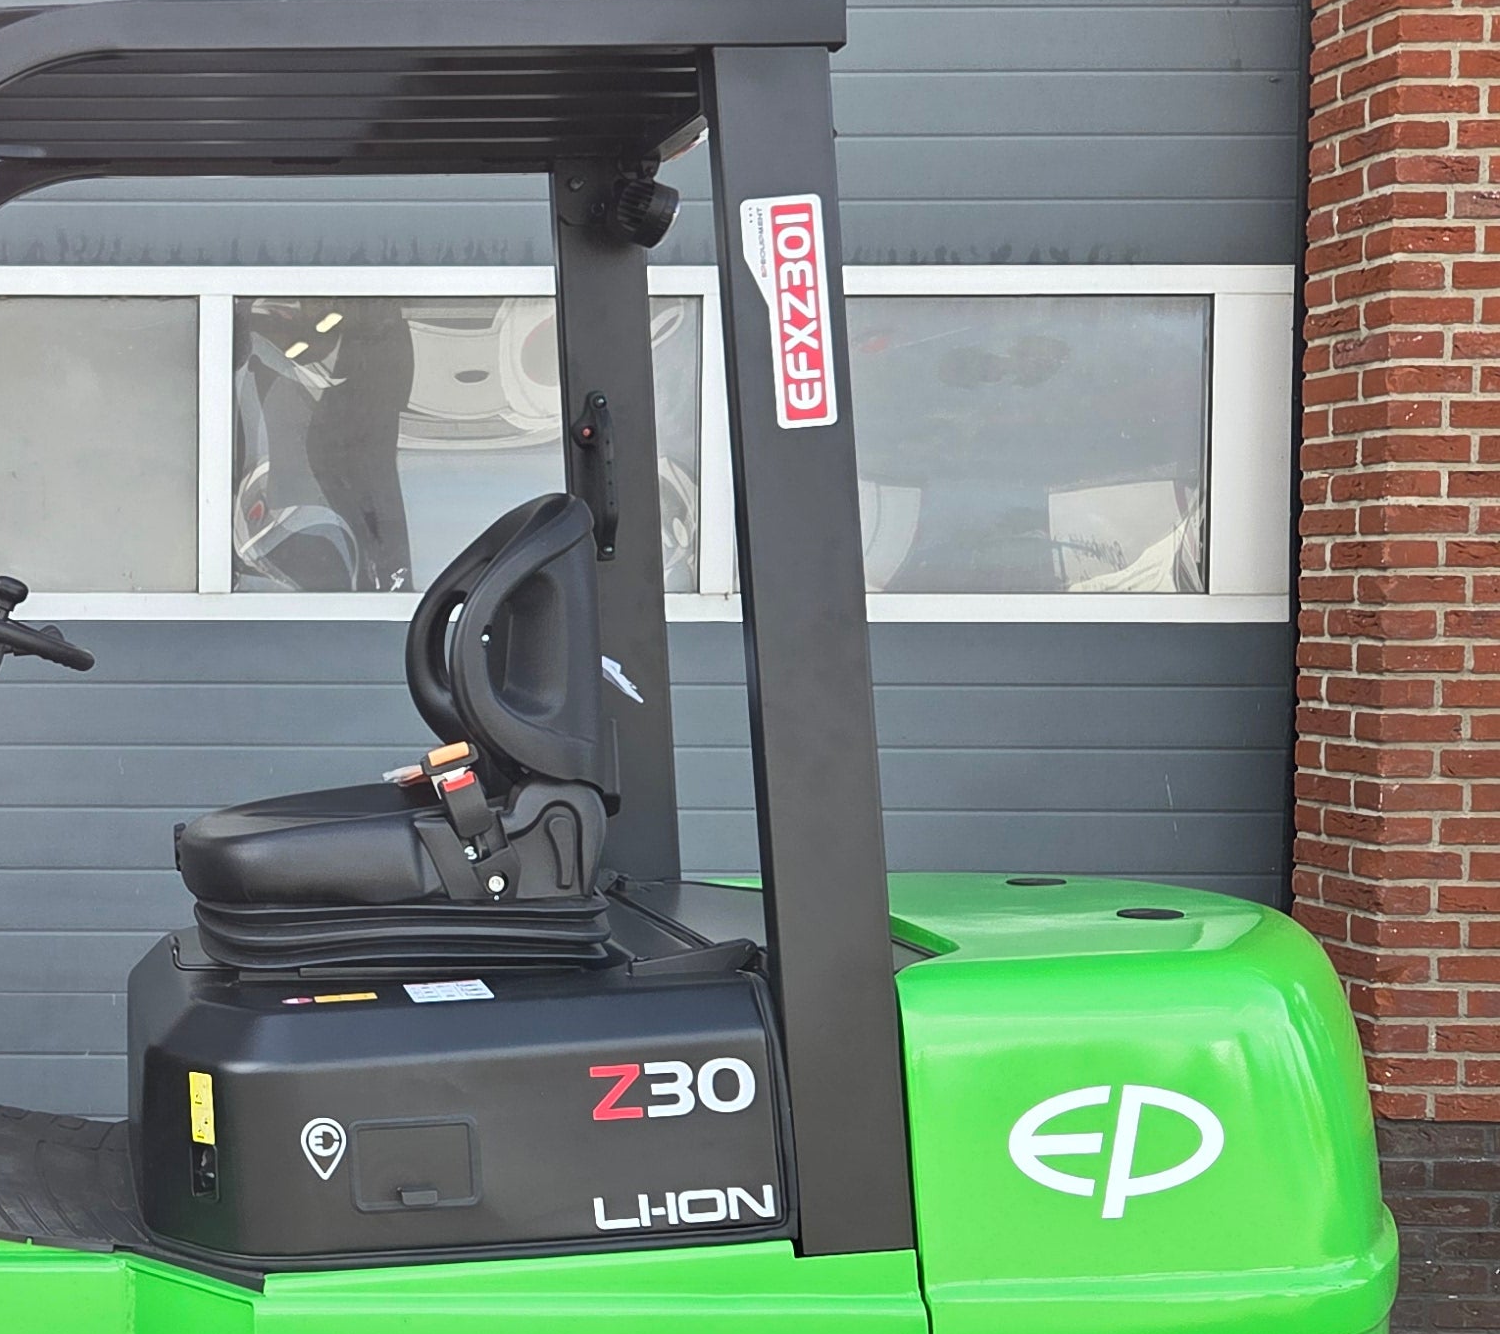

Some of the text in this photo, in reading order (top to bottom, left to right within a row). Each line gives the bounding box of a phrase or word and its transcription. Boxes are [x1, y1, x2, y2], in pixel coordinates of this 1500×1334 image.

[755, 207, 767, 265] EQUIPMENT
[775, 212, 822, 410] EFXZ301
[589, 1057, 756, 1121] Z30
[1008, 1084, 1225, 1219] EP
